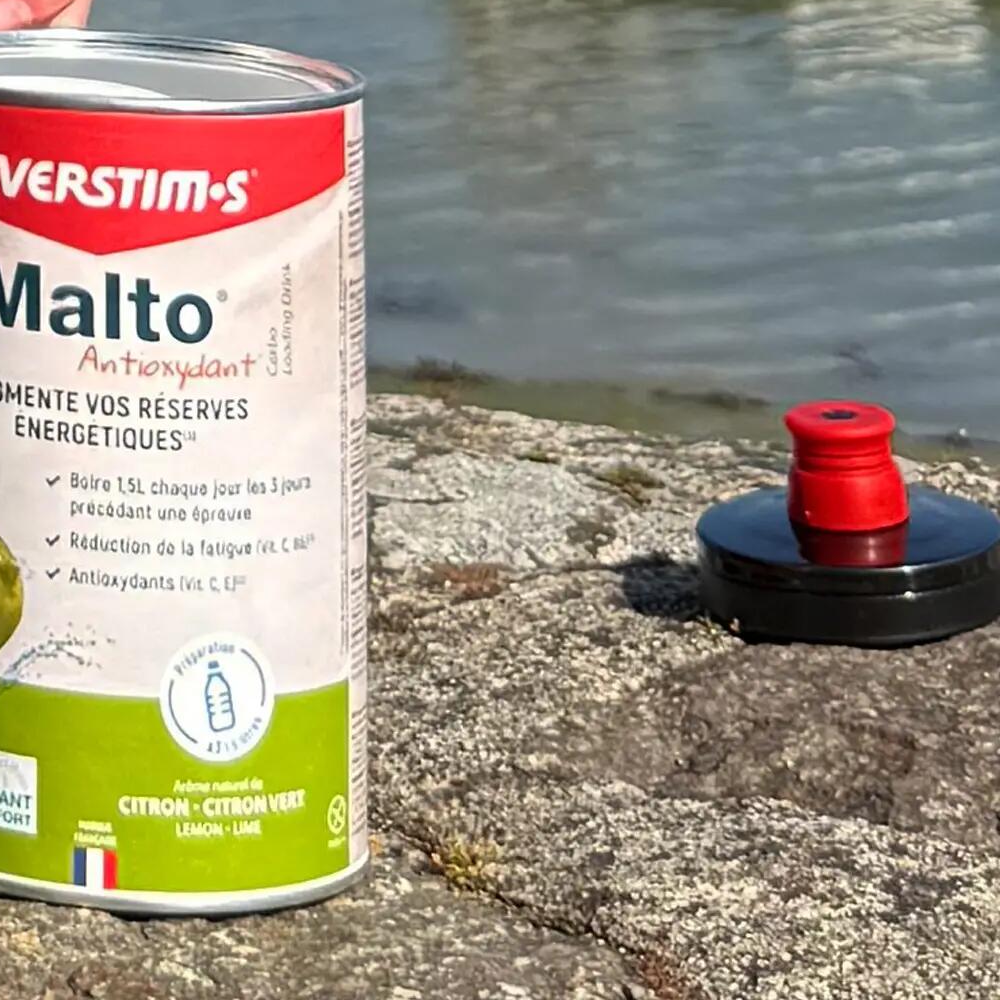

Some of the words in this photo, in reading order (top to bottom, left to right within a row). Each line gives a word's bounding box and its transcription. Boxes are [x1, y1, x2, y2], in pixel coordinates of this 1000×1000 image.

[77, 344, 257, 390] Antioxydant
[85, 393, 130, 418] VOS
[138, 392, 249, 420] RÉSERVES
[69, 472, 111, 493] Boire
[150, 478, 208, 501] chaque
[69, 499, 152, 521] précédant
[157, 507, 188, 522] une
[69, 531, 151, 555] Réduction
[156, 540, 176, 557] de
[180, 539, 195, 557] la
[200, 538, 253, 560] fatigue
[68, 567, 176, 593] Antioxydants
[118, 795, 190, 818] CITRON
[201, 793, 267, 817] CITRON
[267, 788, 306, 813] VERT
[175, 821, 224, 839] LEMON
[232, 819, 262, 837] LIME
